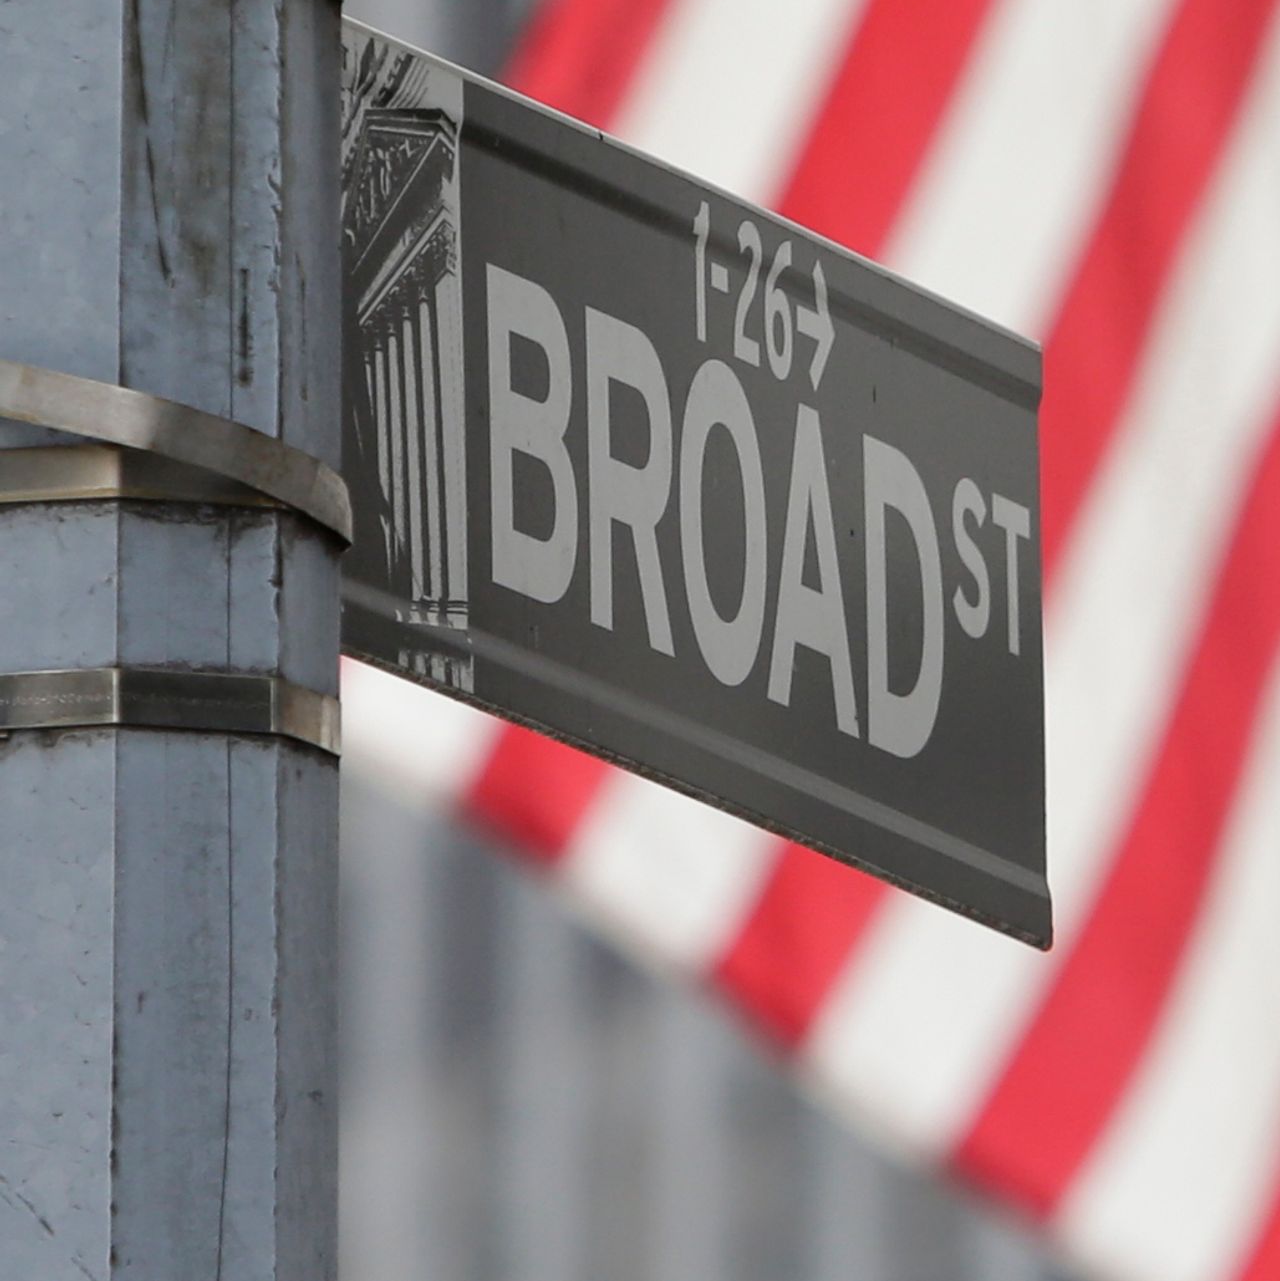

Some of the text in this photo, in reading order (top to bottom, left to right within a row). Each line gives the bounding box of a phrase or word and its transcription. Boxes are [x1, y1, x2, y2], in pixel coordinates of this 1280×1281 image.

[693, 200, 792, 380] 1-26
[487, 263, 1030, 757] BROAD ST
